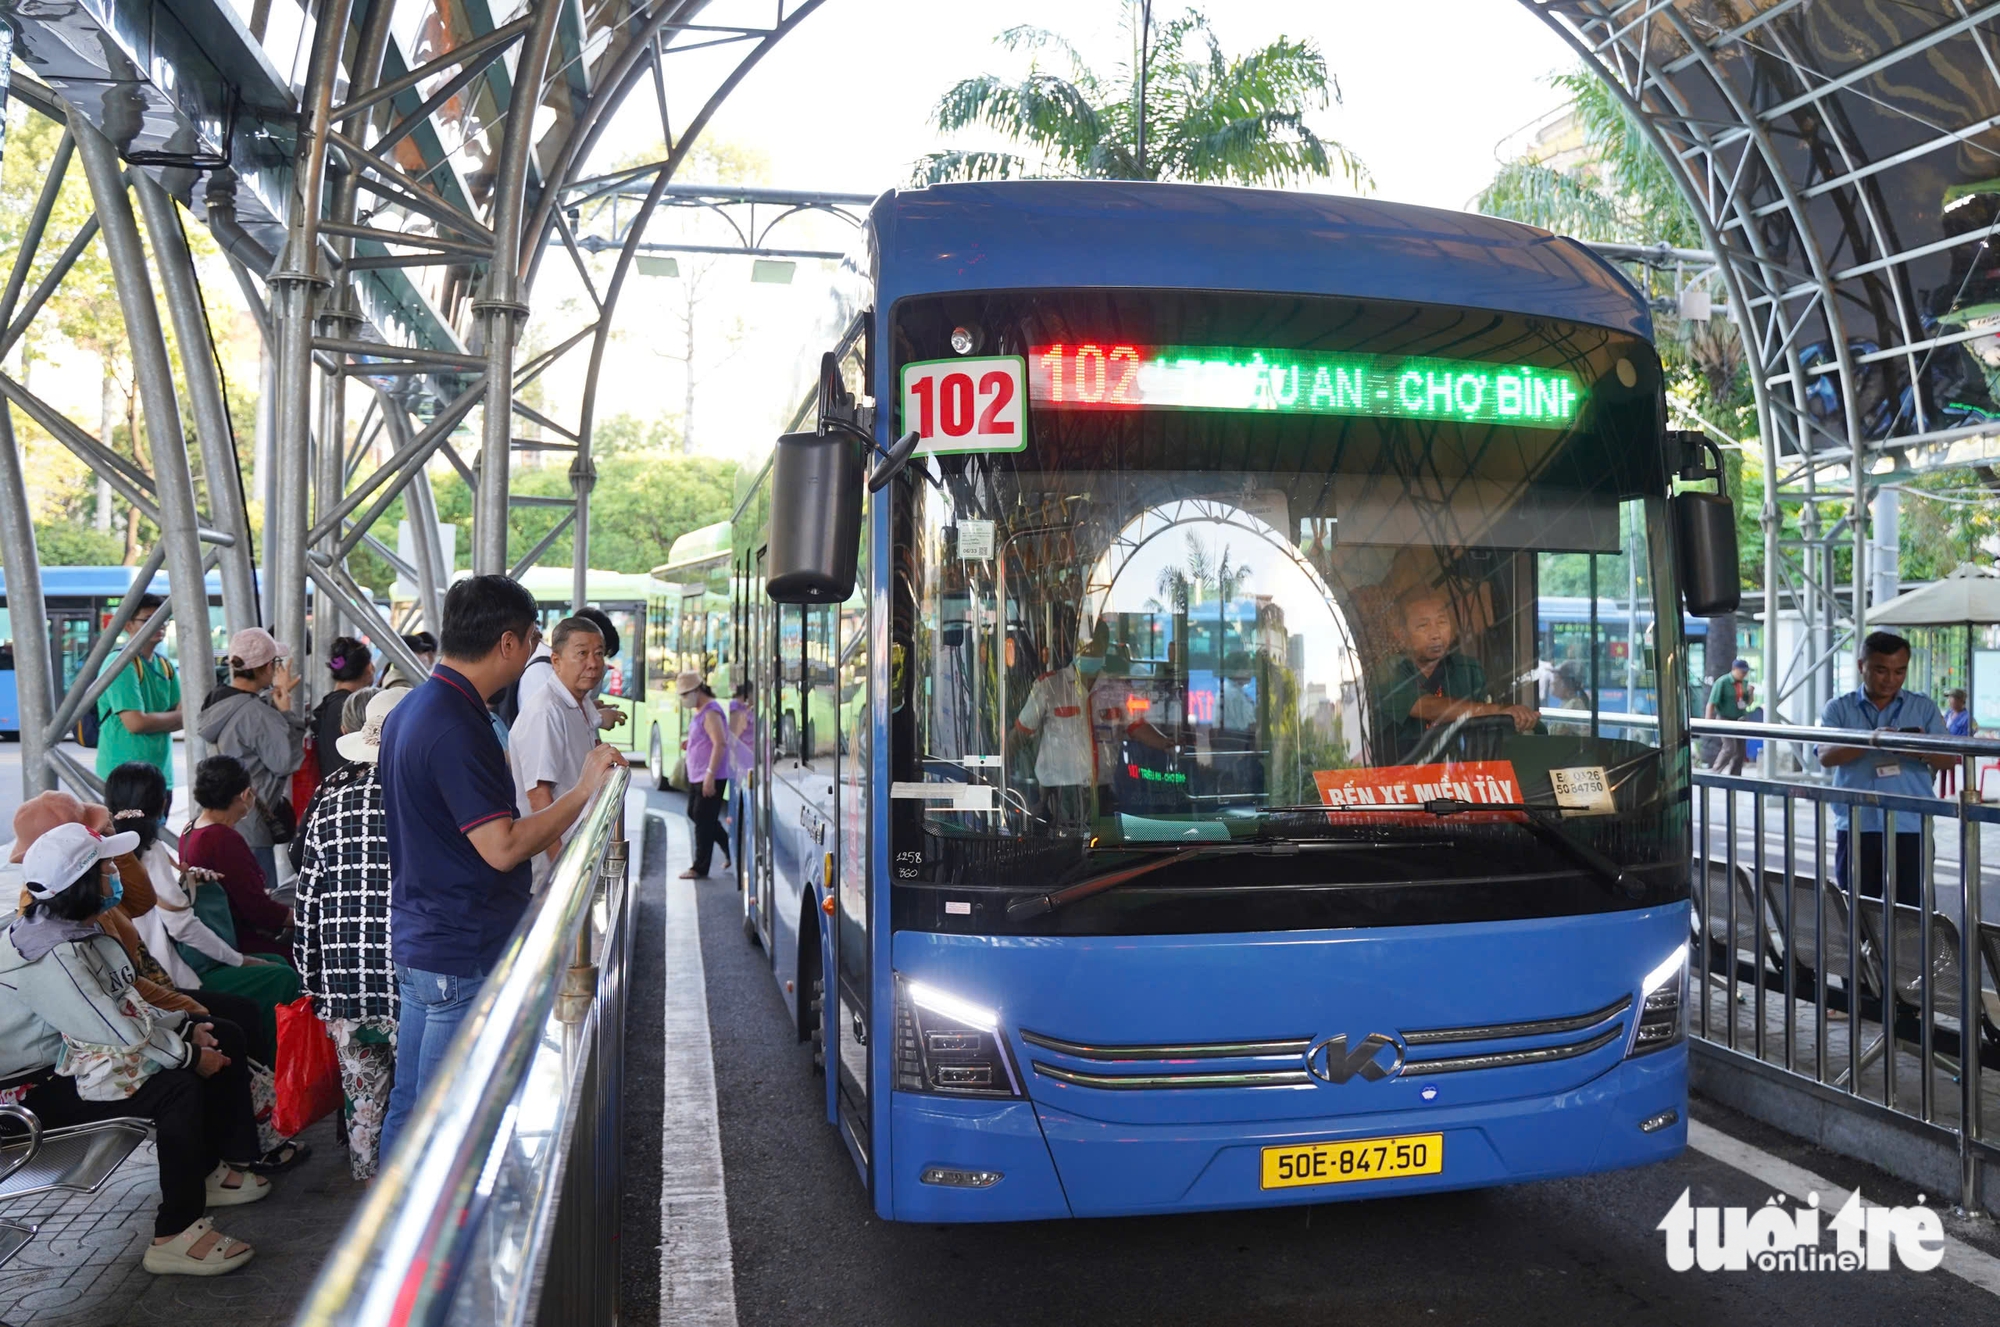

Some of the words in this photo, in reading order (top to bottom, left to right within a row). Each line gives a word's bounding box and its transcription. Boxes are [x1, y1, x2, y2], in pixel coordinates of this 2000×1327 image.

[911, 370, 1015, 439] 102
[1041, 343, 1140, 405] 102
[1309, 366, 1364, 408] AN
[1398, 370, 1488, 420] CHỢ
[1328, 779, 1376, 806] BẾN
[1474, 775, 1515, 805] TÂY
[1278, 1143, 1427, 1181] 50E-847.50
